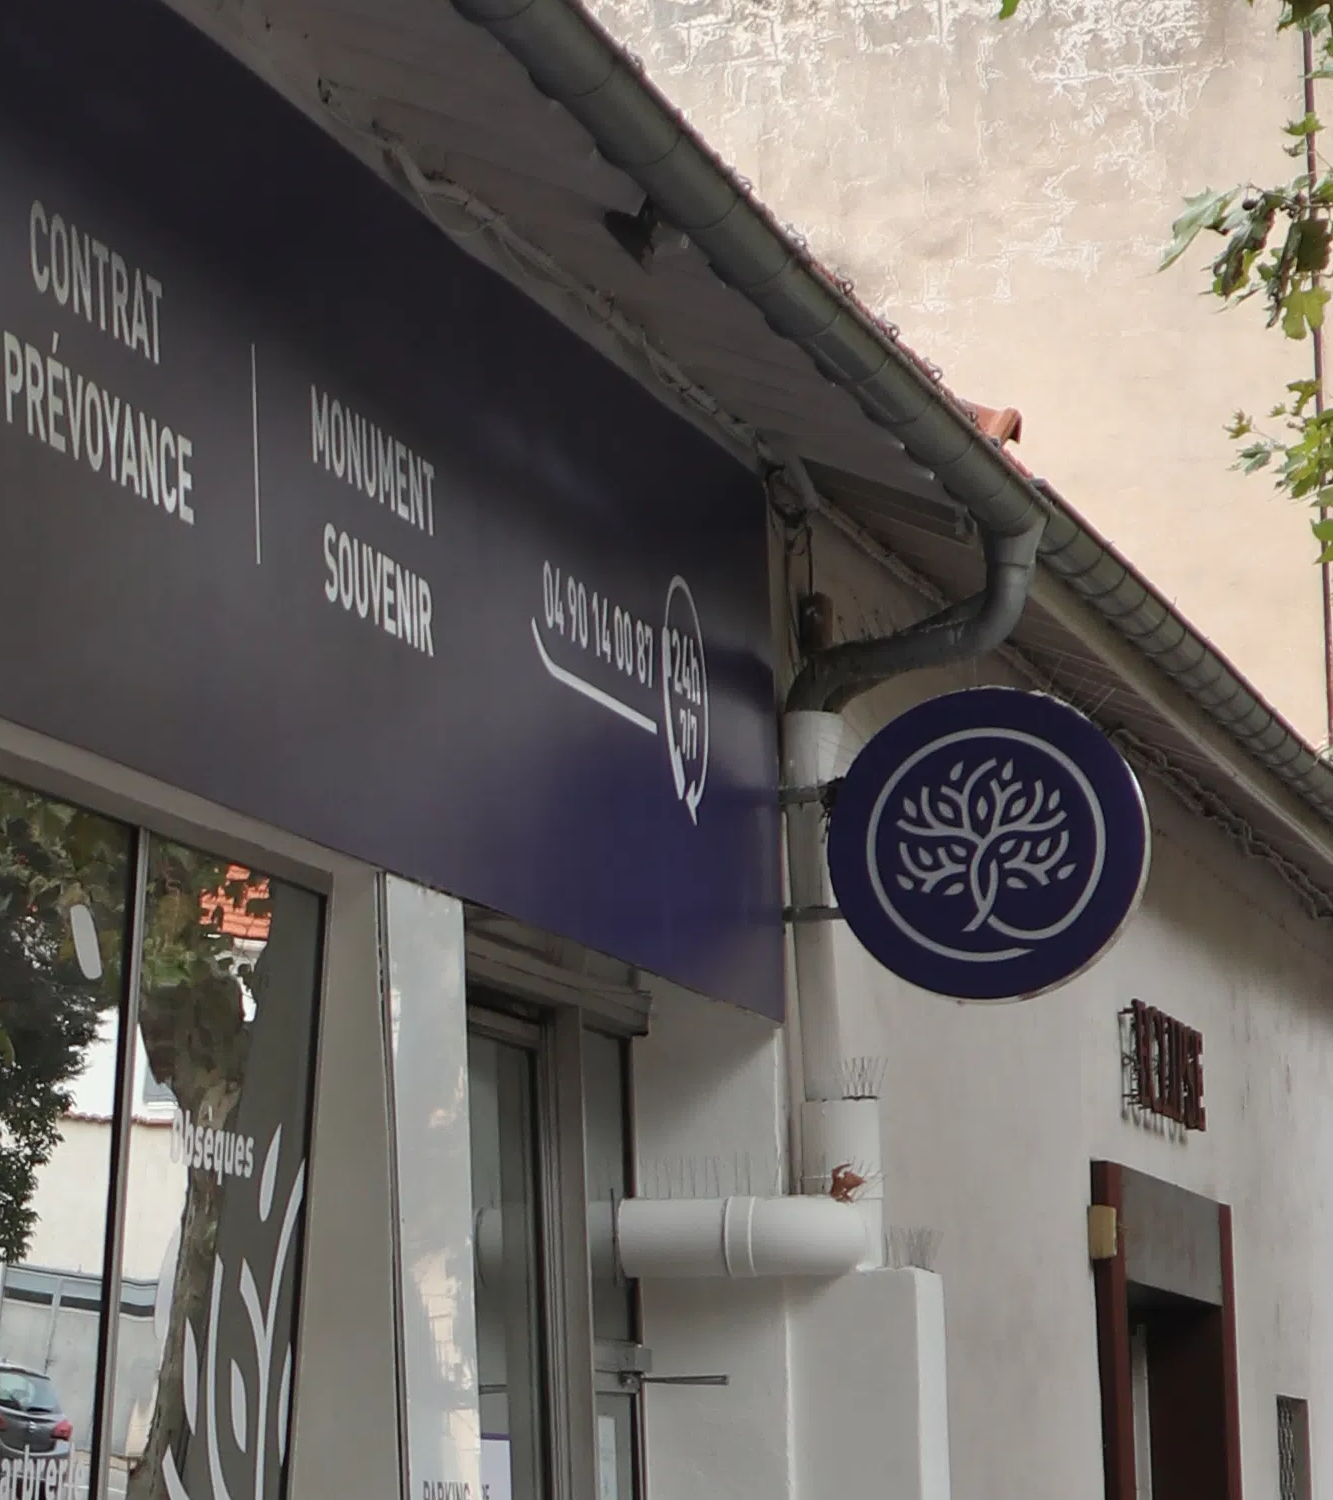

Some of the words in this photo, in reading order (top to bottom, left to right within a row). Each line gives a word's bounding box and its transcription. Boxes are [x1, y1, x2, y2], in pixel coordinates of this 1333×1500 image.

[30, 200, 163, 364] CONTRAT
[4, 330, 195, 525] PRÉVOYANCE
[311, 384, 435, 536] MONUMENT
[323, 522, 434, 658] SOUVENIR
[543, 560, 564, 635] 04
[567, 576, 589, 649] 90
[592, 592, 611, 664] 14
[614, 605, 633, 676] 00
[636, 619, 654, 688] 87
[672, 628, 701, 706] 24h
[679, 707, 697, 761] 7/7
[170, 1105, 254, 1185] Obsèques
